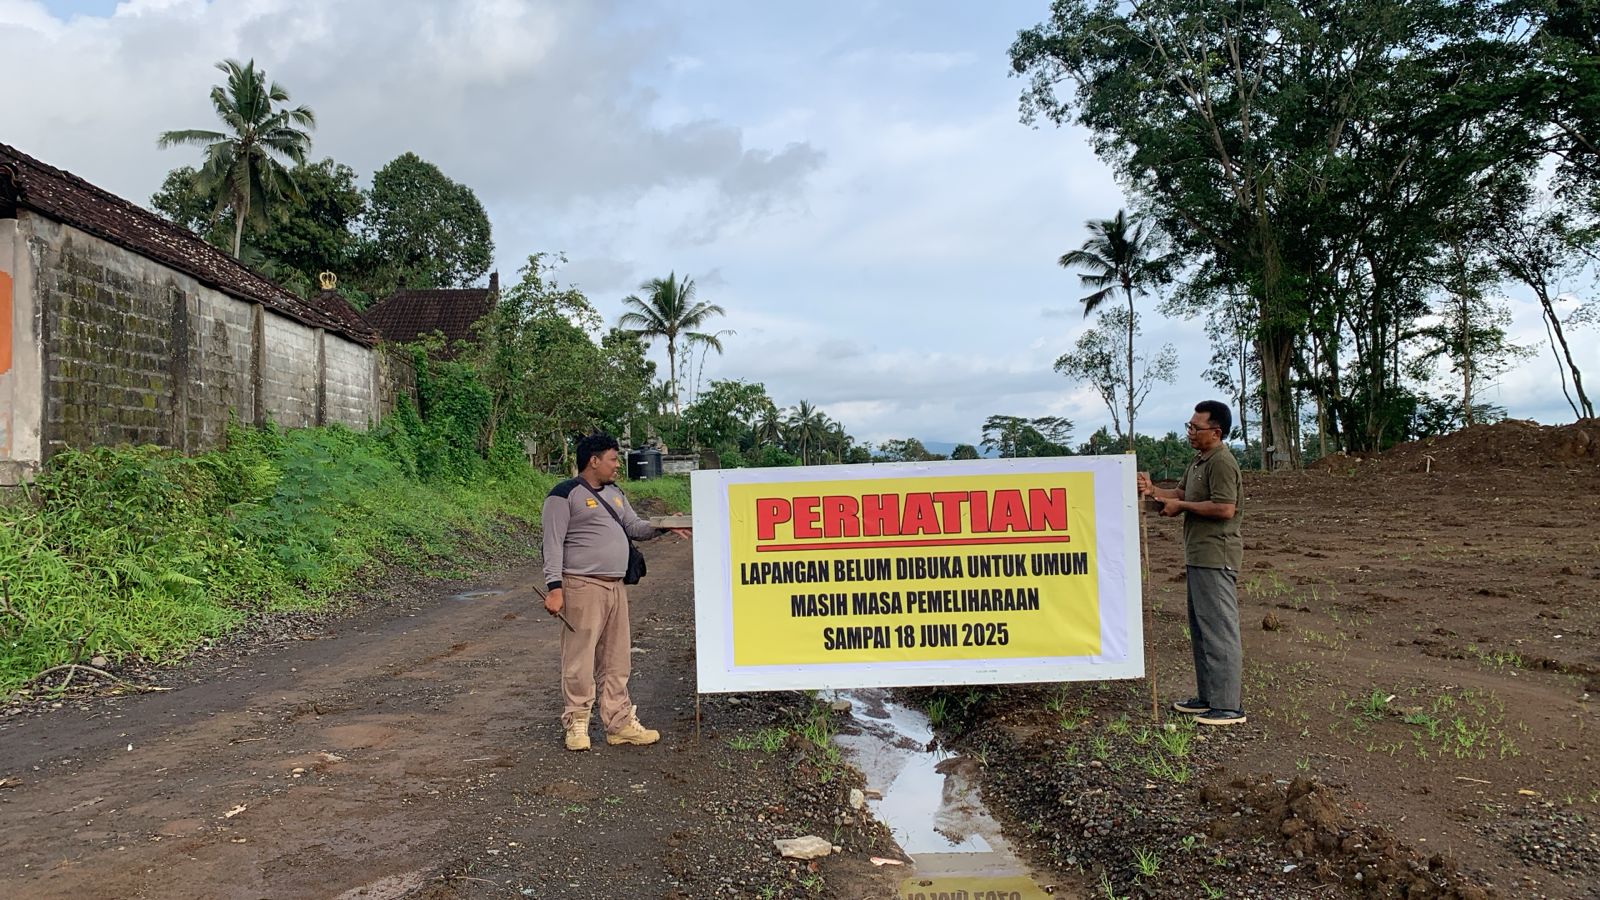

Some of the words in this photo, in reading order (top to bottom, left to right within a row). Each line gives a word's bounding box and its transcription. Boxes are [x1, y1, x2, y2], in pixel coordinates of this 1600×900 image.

[756, 487, 1068, 540] PERHATIAN
[741, 558, 829, 585] LAPANGAN
[834, 556, 891, 581] BELUM
[896, 555, 964, 580] DIBUKA
[967, 554, 1027, 578] UNTUK
[1031, 552, 1088, 576] UMUM
[791, 592, 847, 617] MASIH
[852, 591, 902, 615] MASA
[907, 588, 1039, 613] PEMELIHARAAN
[824, 626, 890, 650] SAMPAI
[895, 625, 915, 648] 18
[920, 624, 957, 648] JUNI
[962, 623, 1008, 646] 2025
